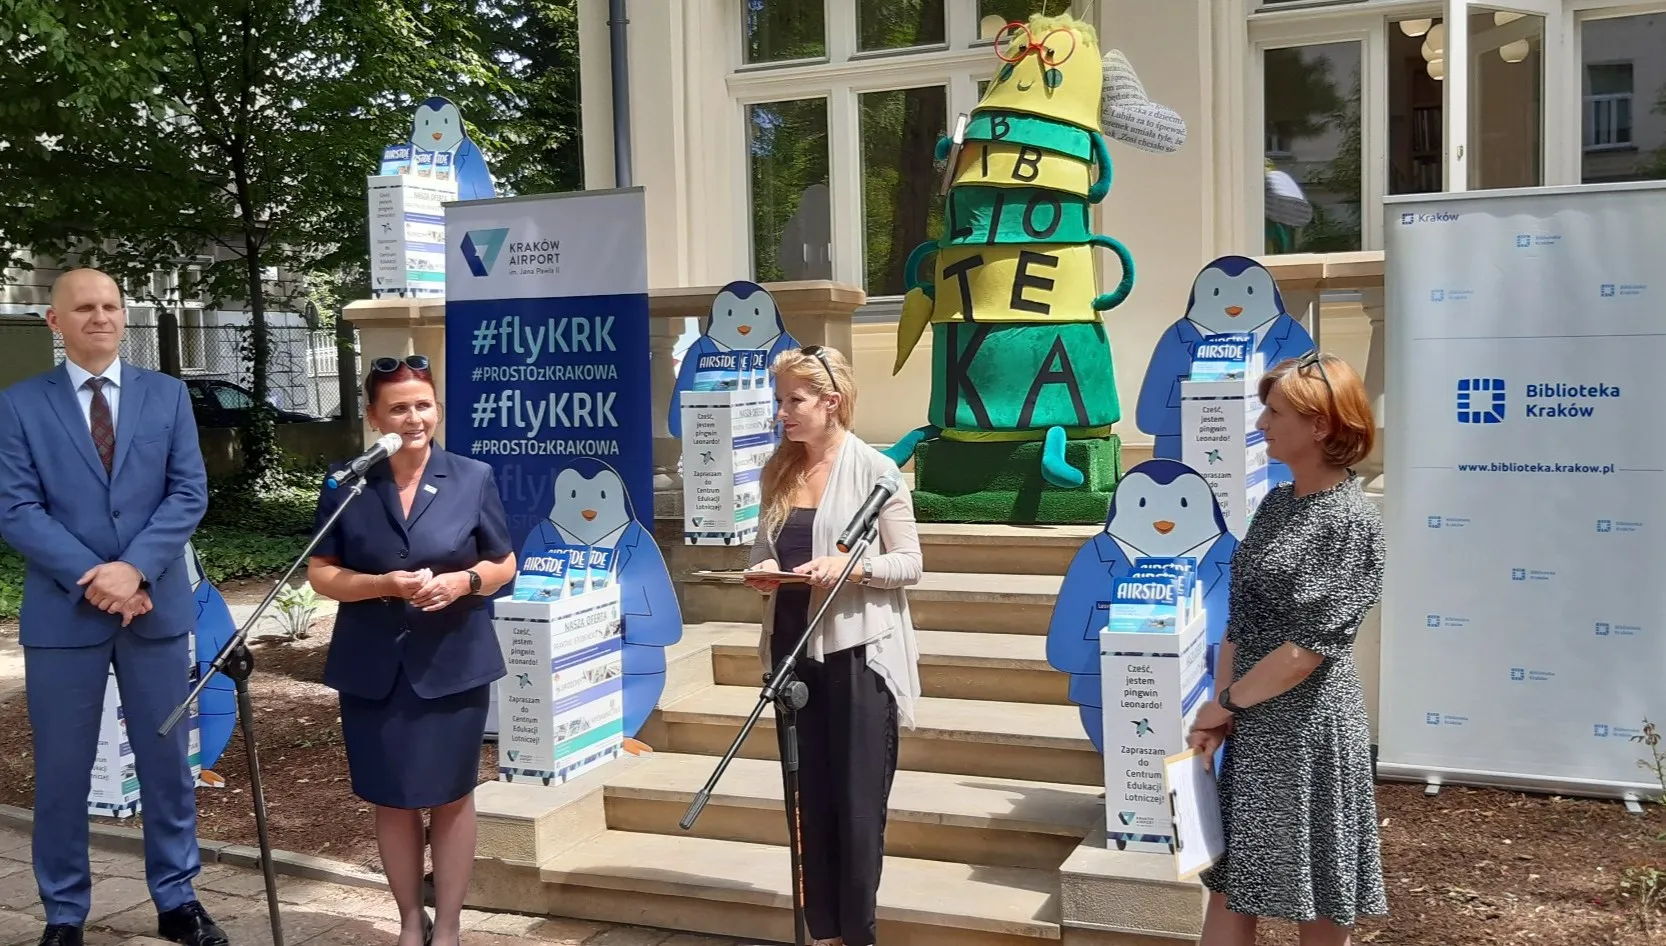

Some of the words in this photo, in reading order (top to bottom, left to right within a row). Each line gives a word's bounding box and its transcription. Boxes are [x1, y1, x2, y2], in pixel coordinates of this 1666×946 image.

[990, 113, 1010, 141] B
[1418, 211, 1460, 223] Kraków
[509, 238, 560, 254] KRAKÓW
[509, 253, 560, 266] AIRPORT
[472, 315, 617, 364] #flyKRK
[472, 364, 618, 382] #PROSTOzKRAKOWA
[1526, 382, 1620, 398] Biblioteka
[471, 390, 619, 438] #flyKRK
[1202, 405, 1223, 414] Cześć,
[1526, 403, 1594, 418] Kraków
[1201, 415, 1225, 424] jestem
[1199, 425, 1227, 434] pingwin
[1195, 434, 1231, 442] Leonardo!
[471, 439, 620, 456] #PROSTOzKRAKOWA
[1458, 462, 1615, 475] www.biblioteka.krakow.pl
[1127, 664, 1153, 674] Cześć,
[1126, 676, 1155, 686] jestem
[1123, 688, 1158, 699] pingwin
[520, 705, 529, 714] do
[1120, 700, 1163, 710] Leonardo!
[512, 715, 538, 724] Centrum
[1120, 745, 1166, 757] Zapraszam
[1138, 757, 1149, 767] do
[1126, 769, 1162, 779] Centrum
[1126, 781, 1162, 793] Edukacji
[1124, 793, 1165, 804] Lotniczej!
